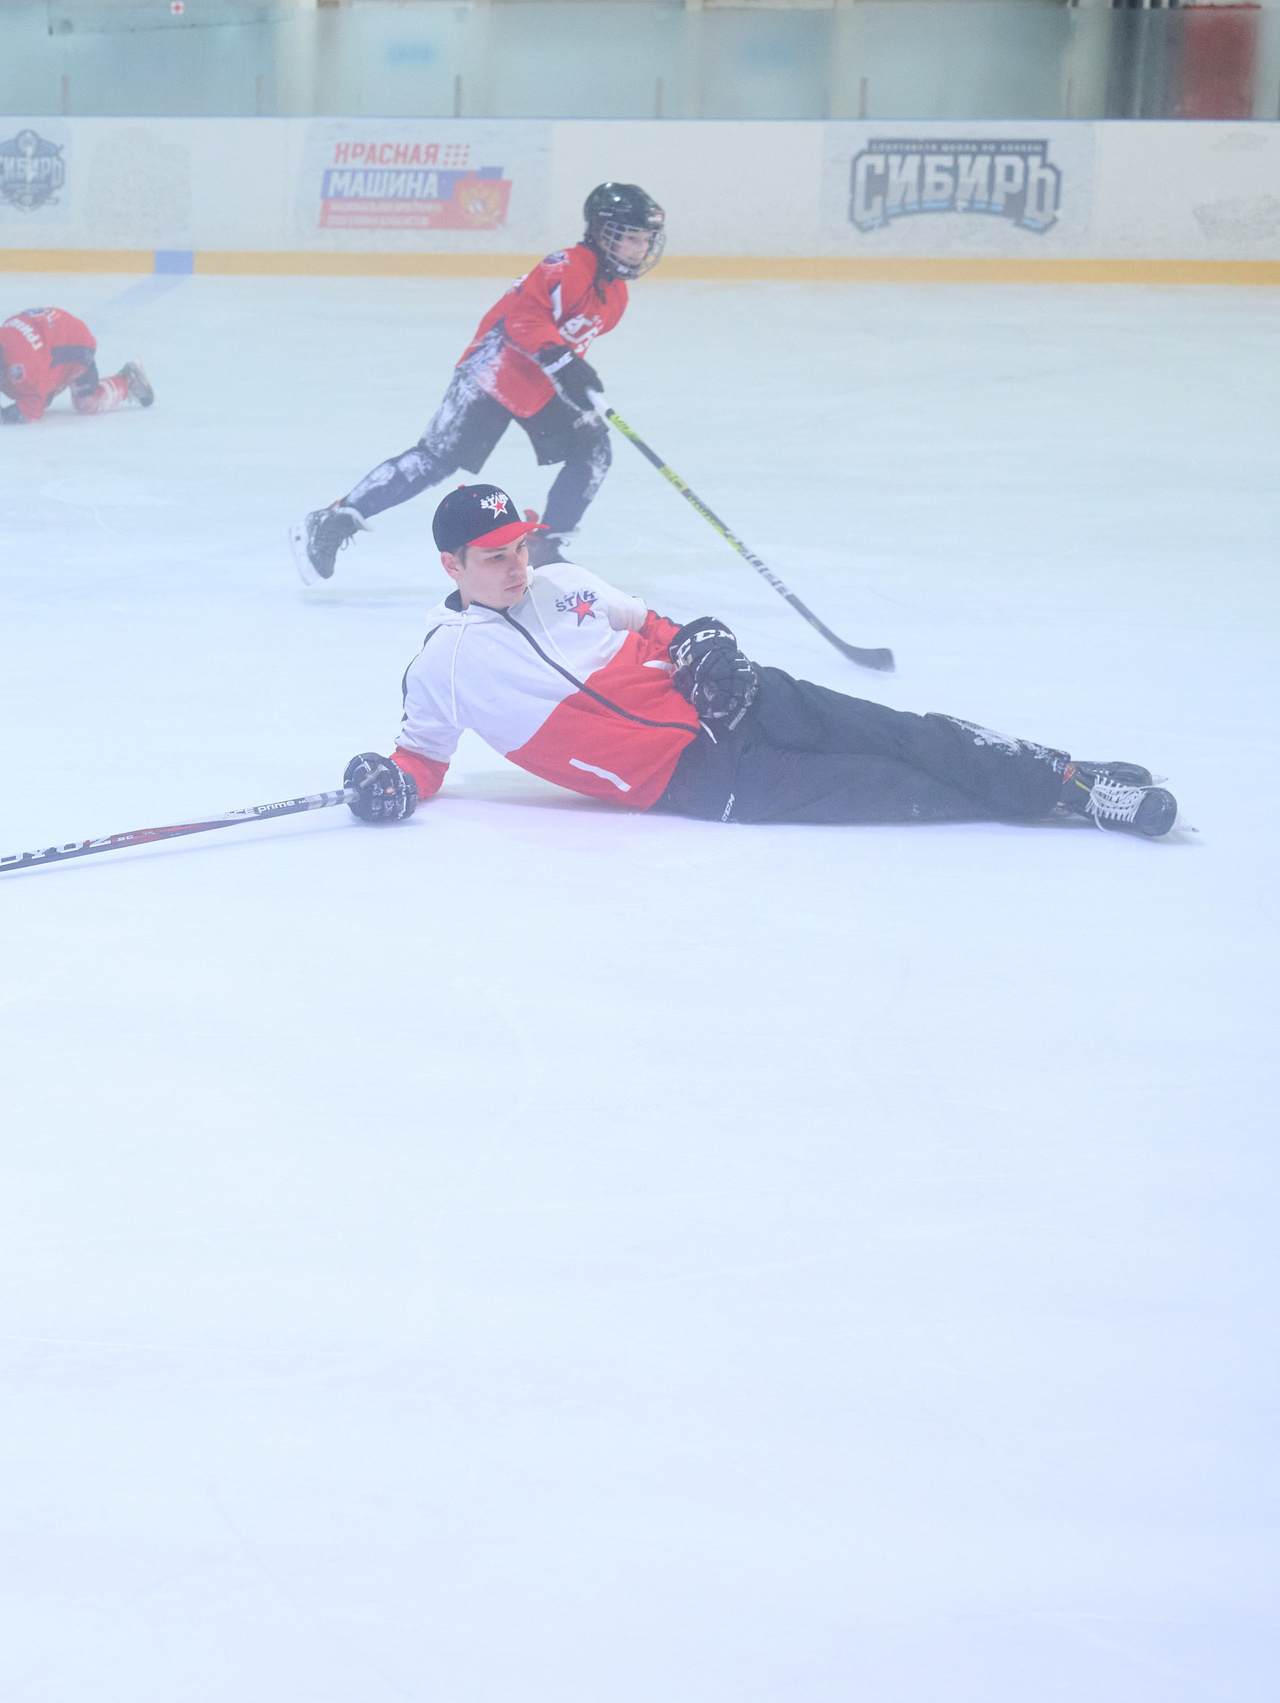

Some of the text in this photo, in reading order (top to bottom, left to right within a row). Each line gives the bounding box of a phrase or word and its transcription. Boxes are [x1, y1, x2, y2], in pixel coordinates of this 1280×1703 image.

[327, 171, 440, 198] МАШИНА
[852, 151, 1060, 229] СИБИРЬ
[676, 629, 736, 658] CCM
[257, 800, 296, 814] prime
[721, 793, 735, 822] CCM
